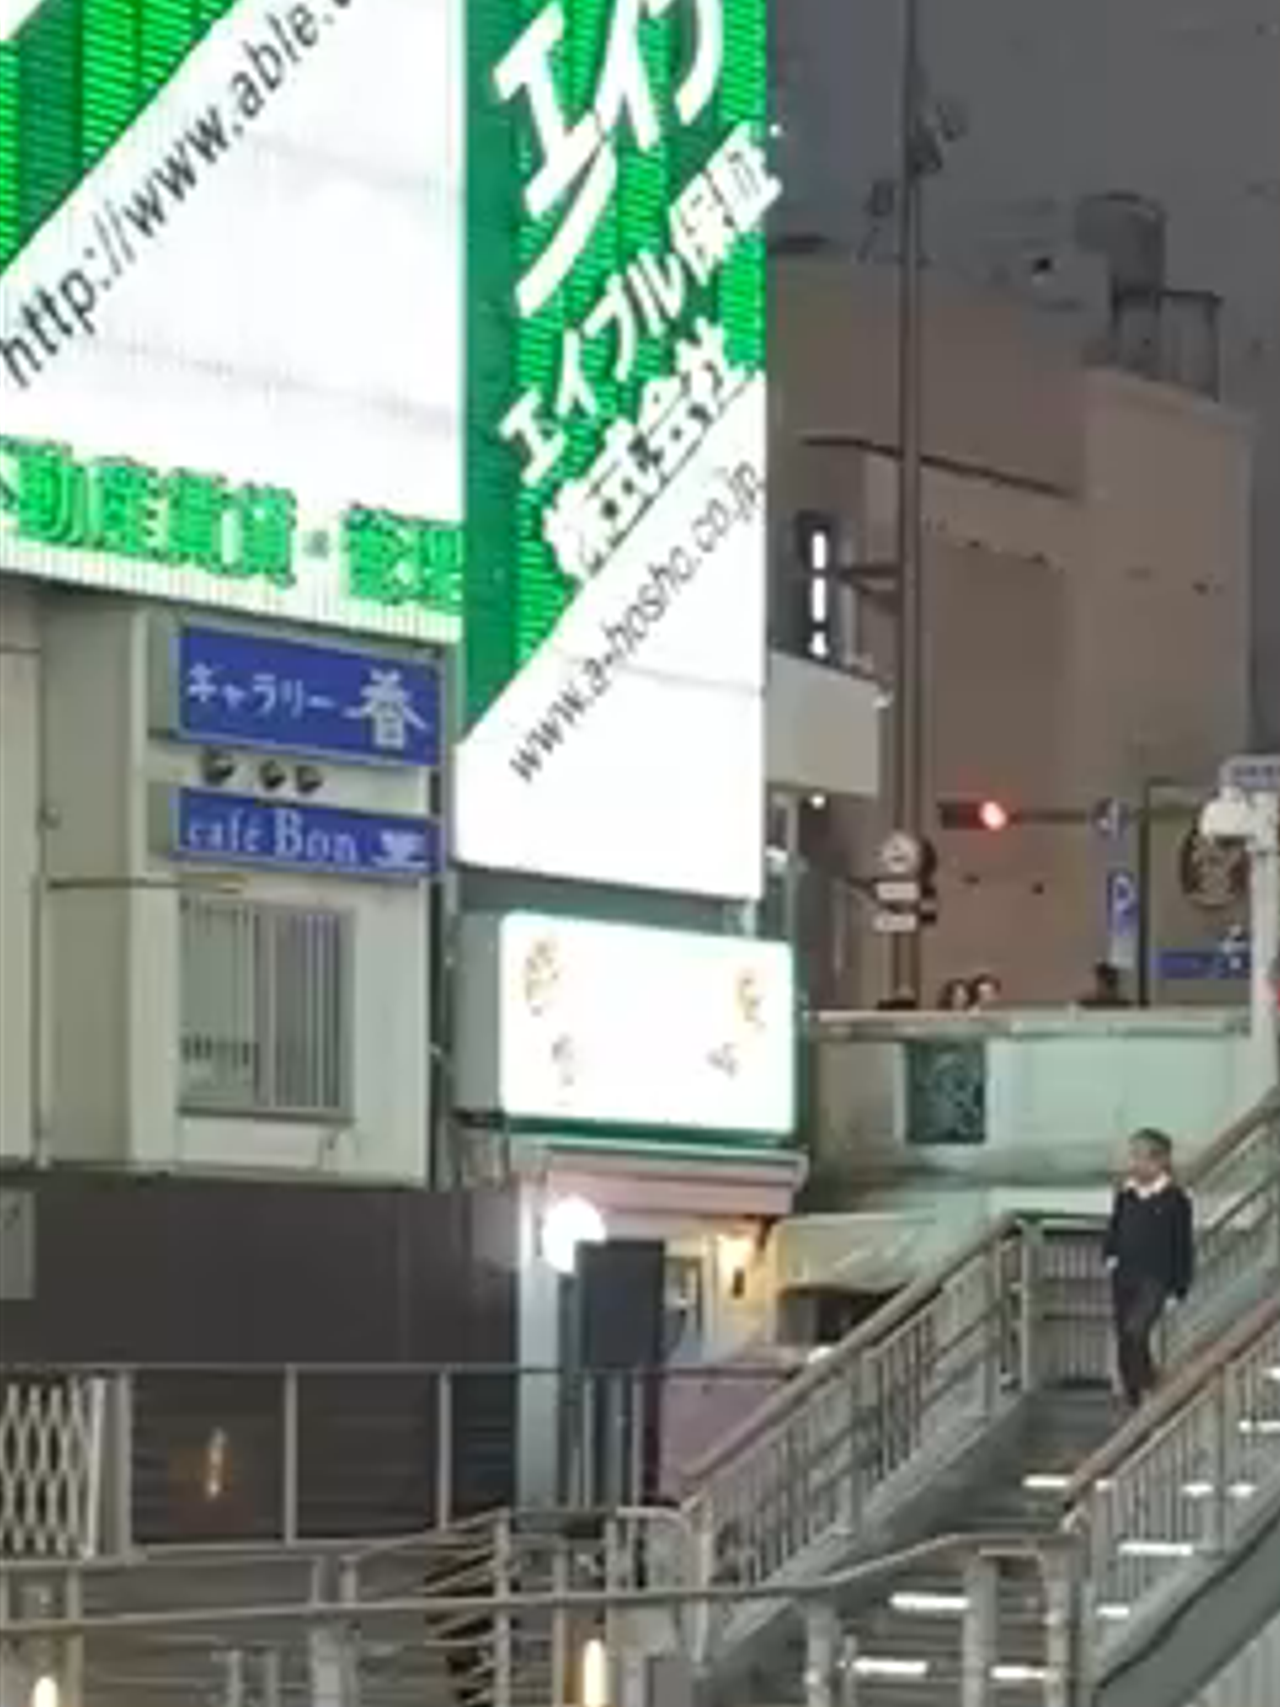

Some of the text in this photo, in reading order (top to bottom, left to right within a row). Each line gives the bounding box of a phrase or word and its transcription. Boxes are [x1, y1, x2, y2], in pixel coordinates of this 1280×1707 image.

[498, 119, 783, 490] エイブル保証
[509, 459, 764, 785] www.a-hosho.co.jp
[274, 809, 359, 864] Bon
